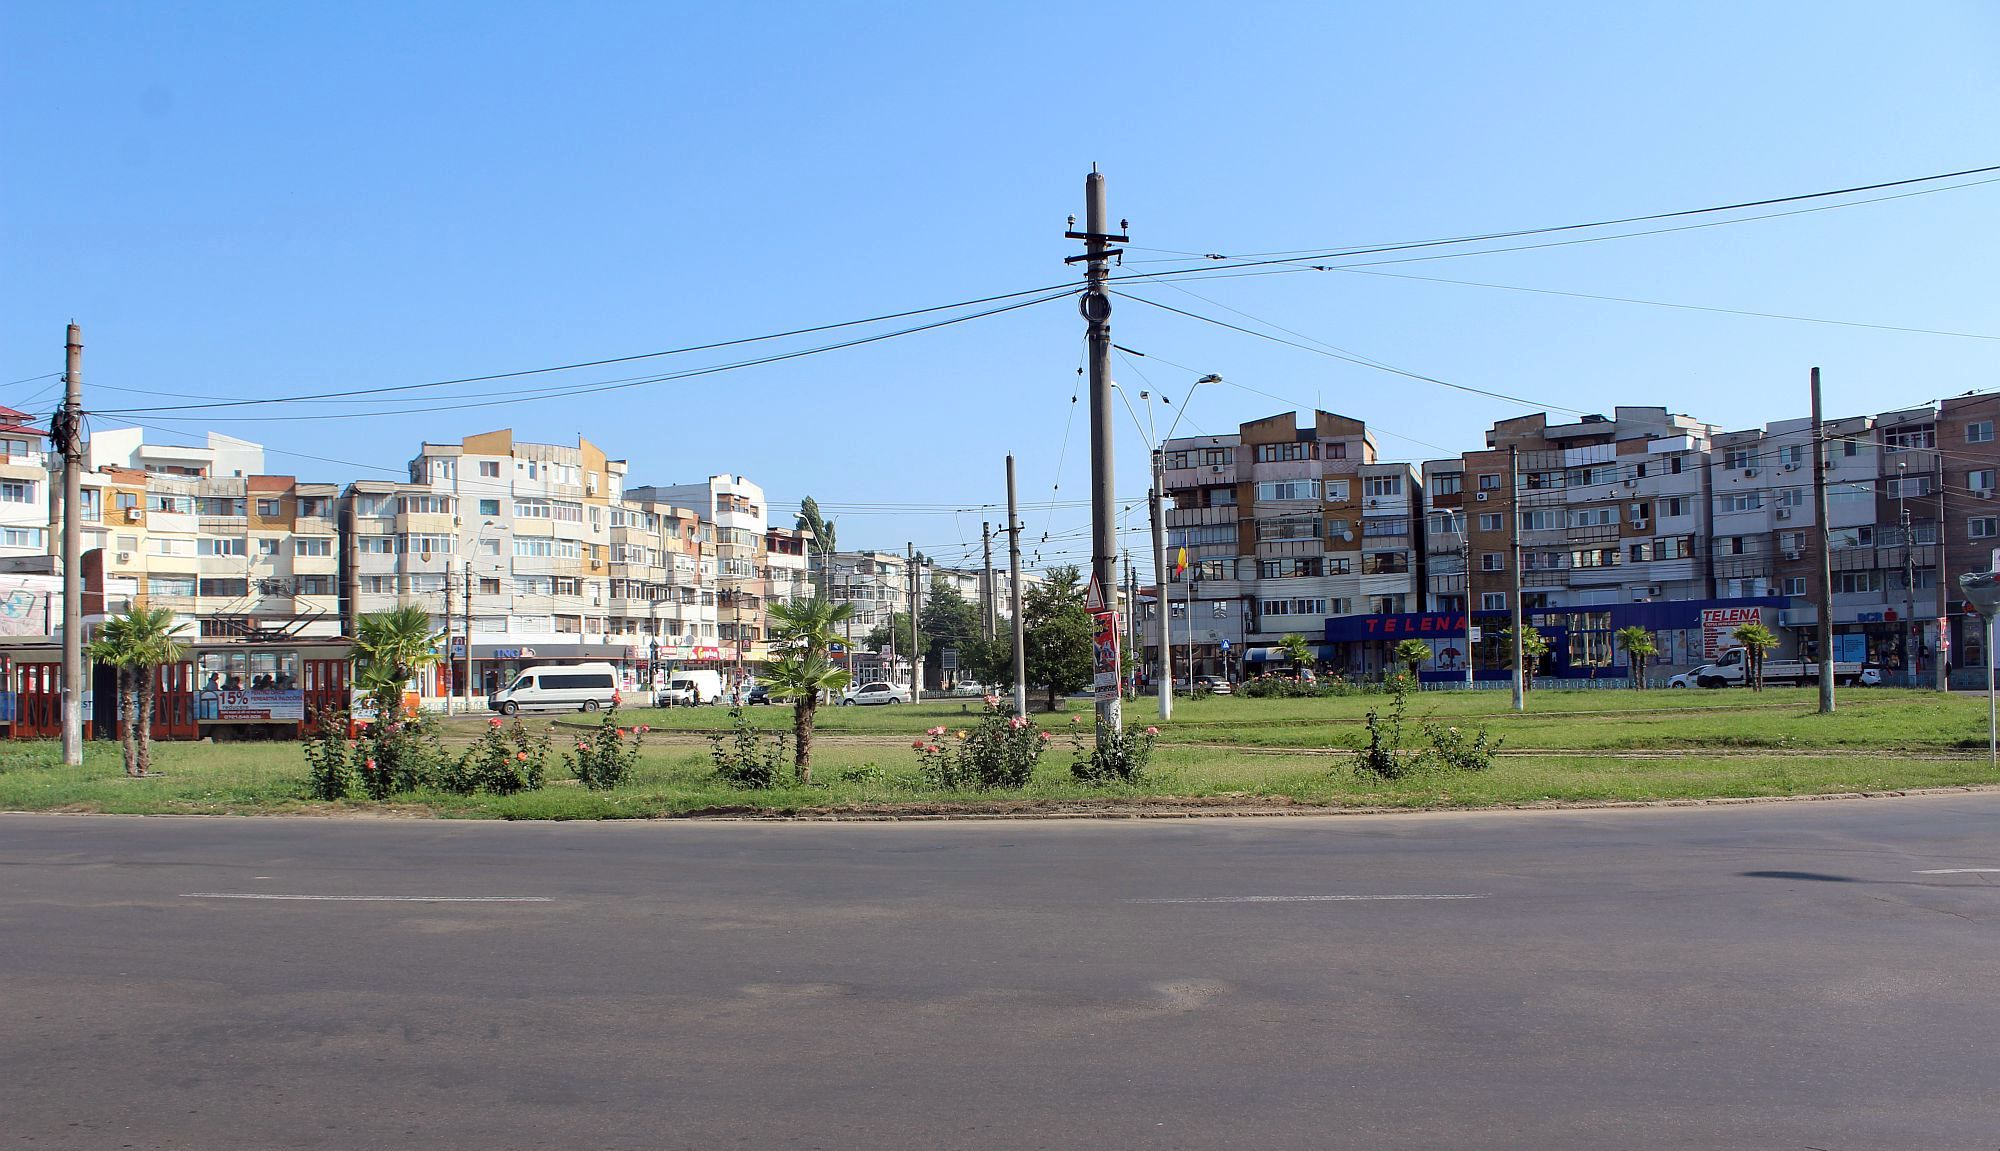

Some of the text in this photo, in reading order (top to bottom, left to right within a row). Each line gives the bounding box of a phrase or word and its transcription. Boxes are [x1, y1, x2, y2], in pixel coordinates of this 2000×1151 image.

[1704, 608, 1760, 621] TELENA
[1857, 612, 1882, 622] BCR
[1366, 616, 1466, 632] TELENA
[495, 648, 519, 658] ING
[219, 690, 249, 705] 15%
